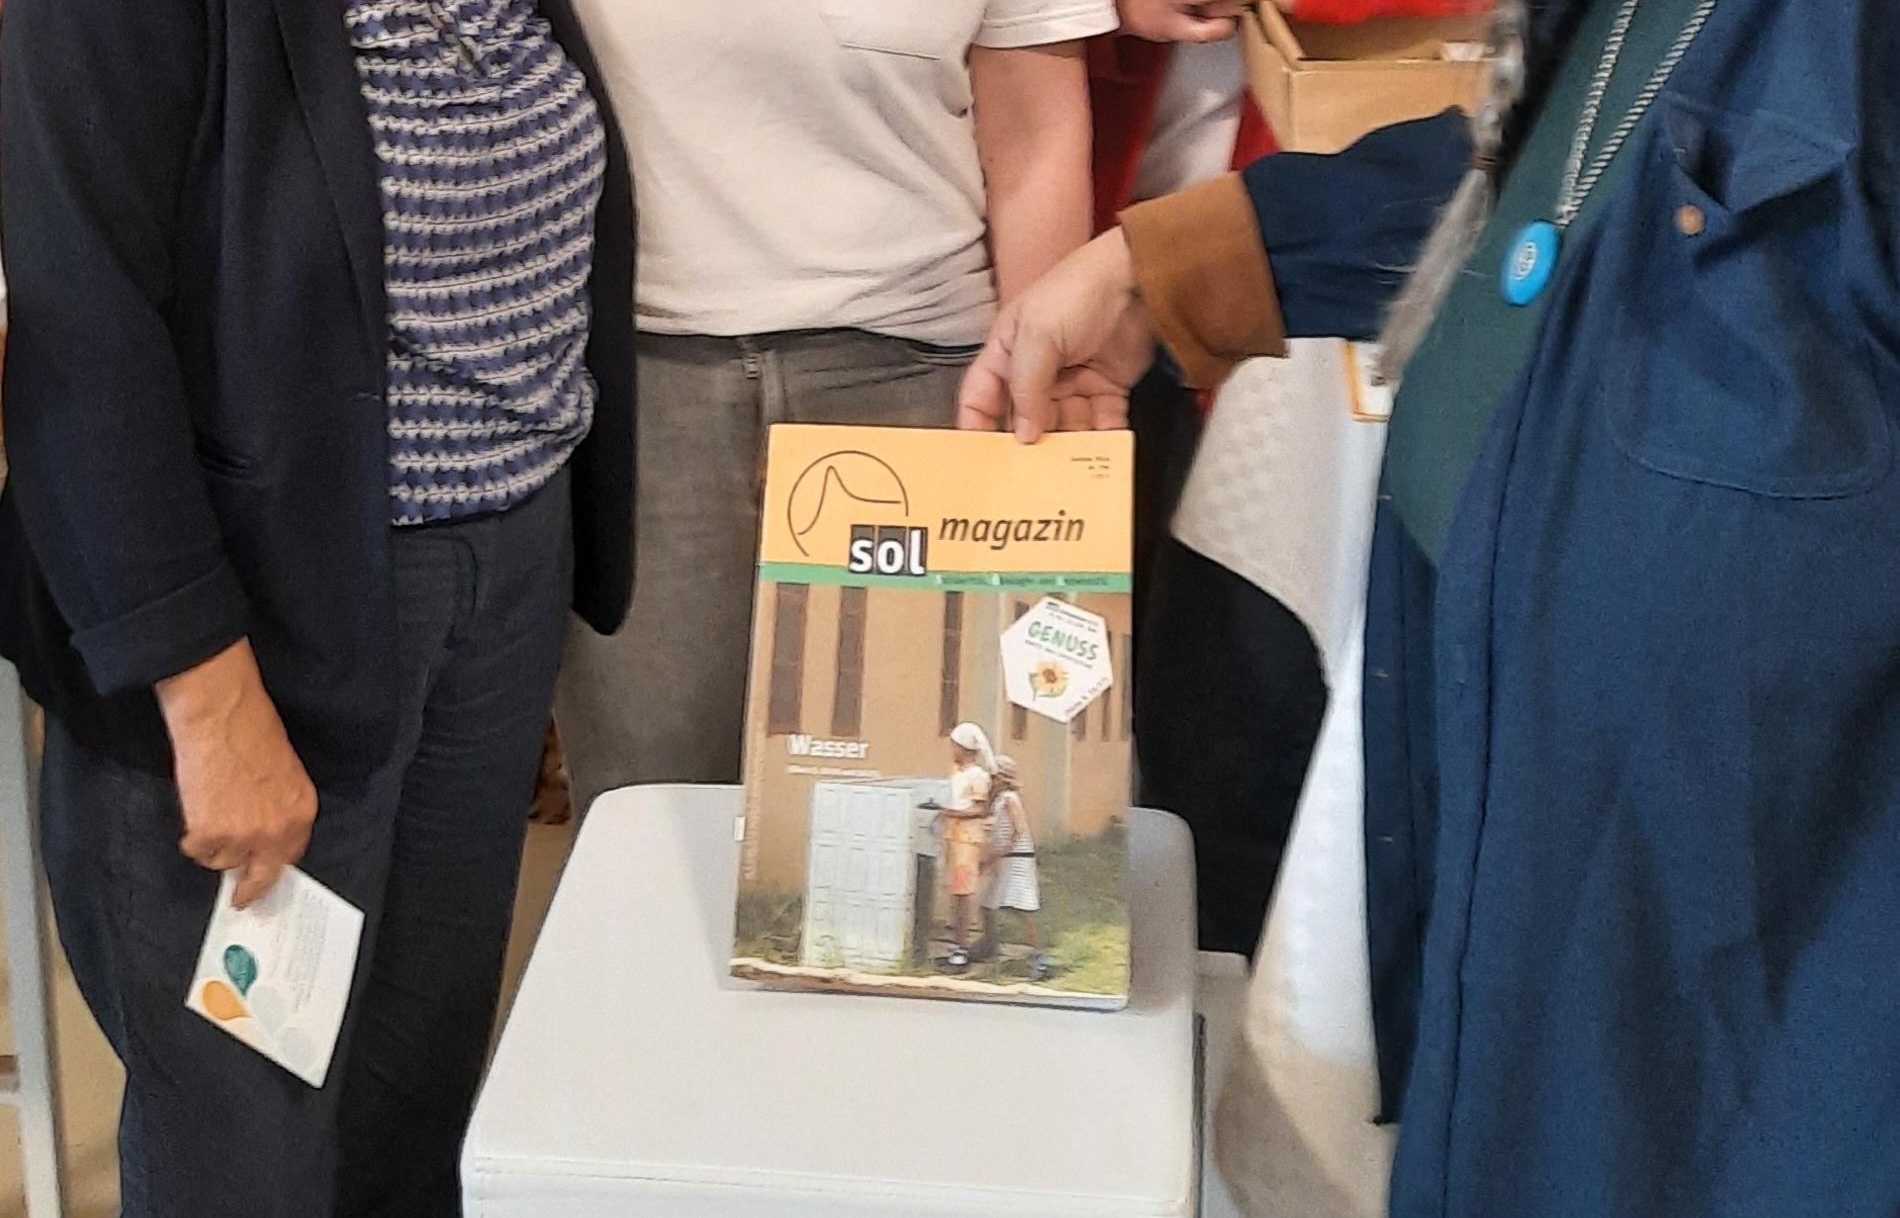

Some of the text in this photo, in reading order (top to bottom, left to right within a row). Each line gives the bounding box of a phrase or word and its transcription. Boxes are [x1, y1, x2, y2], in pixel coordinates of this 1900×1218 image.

[849, 509, 1086, 575] sol magazin
[1027, 620, 1100, 661] GENUSS
[787, 733, 870, 759] Wasser
